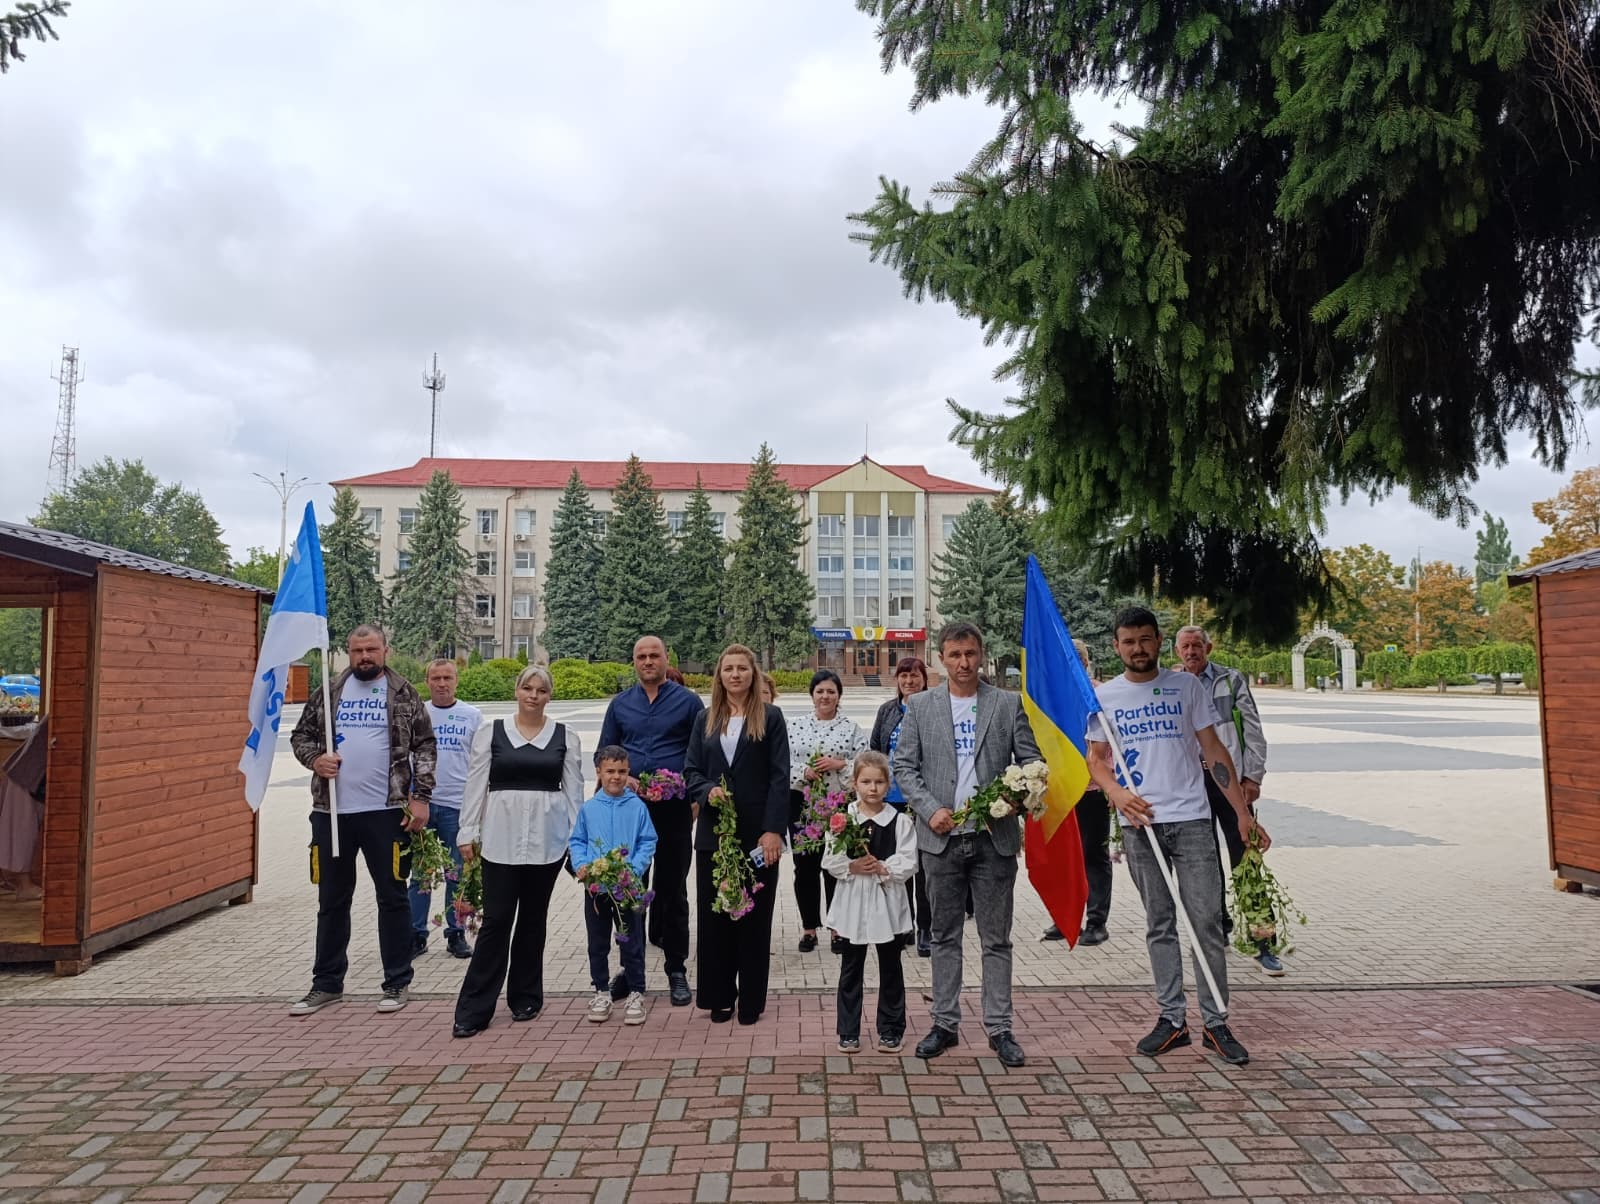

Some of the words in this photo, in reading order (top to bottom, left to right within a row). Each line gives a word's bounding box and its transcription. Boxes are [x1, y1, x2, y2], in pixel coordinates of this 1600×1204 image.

[1114, 701, 1182, 723] Partidul
[1117, 719, 1178, 737] Nostru.
[438, 736, 461, 746] tru.
